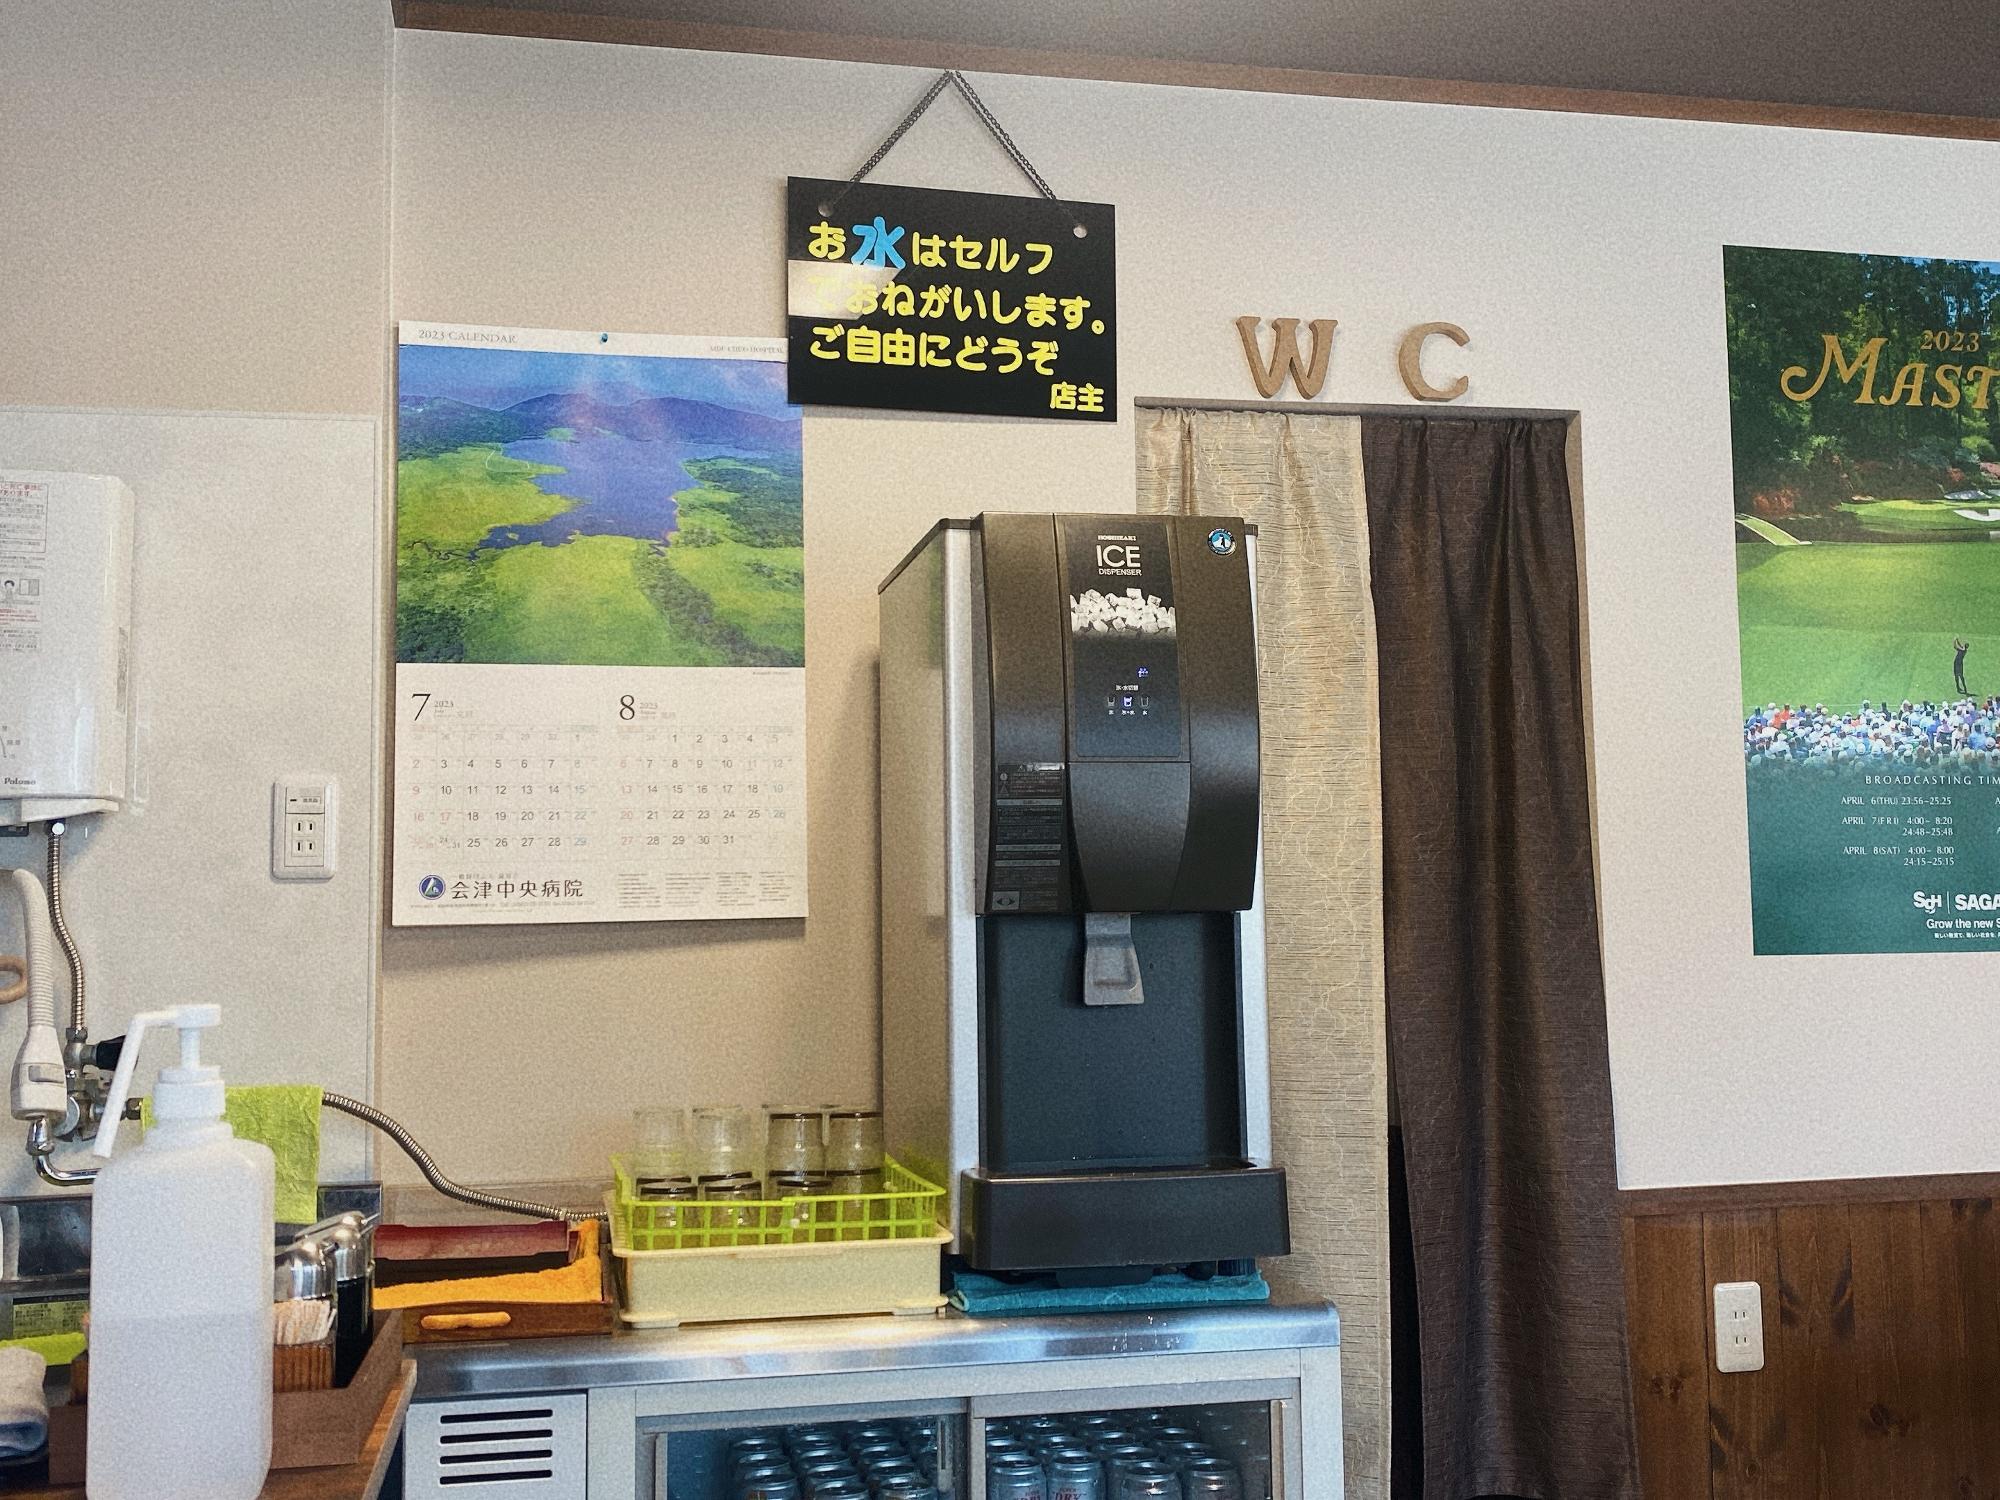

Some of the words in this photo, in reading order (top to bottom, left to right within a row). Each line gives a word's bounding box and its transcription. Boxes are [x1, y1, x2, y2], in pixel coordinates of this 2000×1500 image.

[808, 216, 1053, 275] お水はセルフ
[806, 275, 1105, 335] でおねがいします。
[418, 329, 445, 340] 2023
[448, 331, 518, 344] CALENDAR
[1919, 329, 1980, 352] 2023
[809, 323, 1059, 375] ご自由にどうぞ
[1780, 334, 2000, 409] MAST
[1050, 381, 1104, 412] 店主
[1096, 544, 1141, 567] ICE
[1098, 568, 1142, 576] DISPENSER
[411, 693, 431, 721] 7
[619, 694, 635, 720] 8
[673, 735, 677, 744] 1
[696, 734, 703, 743] 2
[722, 734, 728, 743] 3
[747, 734, 753, 743] 4
[441, 759, 448, 768] 3
[467, 759, 474, 768] 4
[495, 759, 502, 768] 5
[521, 759, 528, 768] 6
[549, 759, 555, 768] 7
[647, 760, 653, 768] 7
[672, 760, 678, 768] 8
[696, 760, 703, 768] 9
[722, 760, 732, 768] 10
[1865, 775, 1972, 785] BROADCASTING
[441, 786, 452, 794] 10
[468, 786, 478, 794] 11
[496, 786, 507, 794] 12
[522, 786, 533, 794] 13
[549, 786, 560, 794] 14
[647, 784, 658, 794] 14
[672, 784, 683, 794] 15
[697, 784, 708, 794] 16
[722, 784, 733, 794] 17
[748, 784, 758, 794] 18
[1841, 796, 1865, 805] APRIL
[468, 812, 479, 820] 18
[495, 812, 507, 820] 19
[521, 812, 534, 820] 20
[548, 812, 560, 820] 21
[647, 810, 658, 819] 21
[672, 810, 684, 819] 22
[697, 810, 710, 819] 23
[723, 810, 735, 819] 24
[747, 810, 760, 819] 25
[1841, 816, 1866, 825] APRIL
[467, 838, 481, 848] 25
[495, 838, 508, 848] 26
[521, 838, 534, 848] 27
[548, 838, 561, 847] 28
[647, 836, 660, 846] 28
[672, 836, 685, 845] 29
[697, 836, 710, 845] 30
[723, 836, 734, 844] 31
[1843, 846, 1867, 855] APRIL
[1873, 846, 1901, 855] 8(SAT)
[451, 879, 583, 899] 会津中央病院
[1926, 918, 1953, 929] Grow
[1955, 918, 1971, 929] the
[1974, 920, 1994, 929] new
